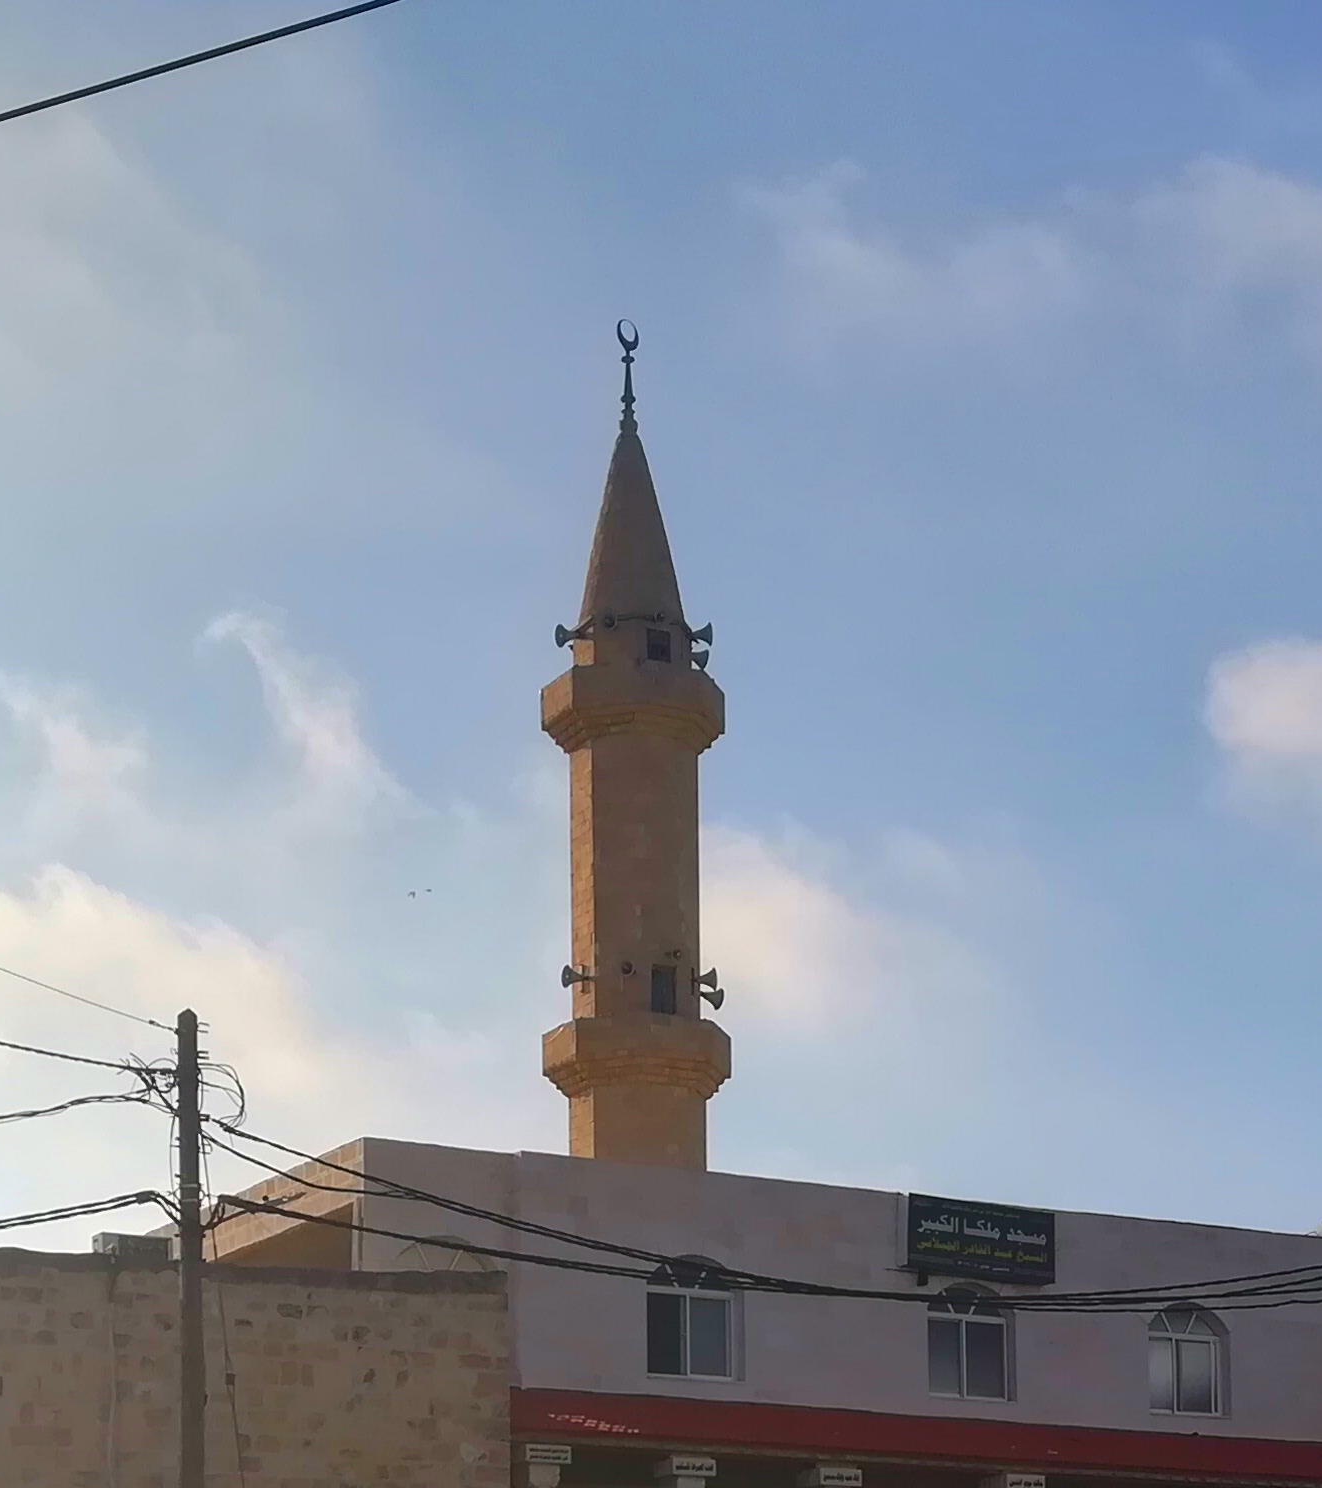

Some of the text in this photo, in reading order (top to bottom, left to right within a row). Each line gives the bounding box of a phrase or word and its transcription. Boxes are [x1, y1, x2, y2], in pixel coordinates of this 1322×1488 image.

[916, 1214, 1048, 1247] مسجد ملكا الكبير
